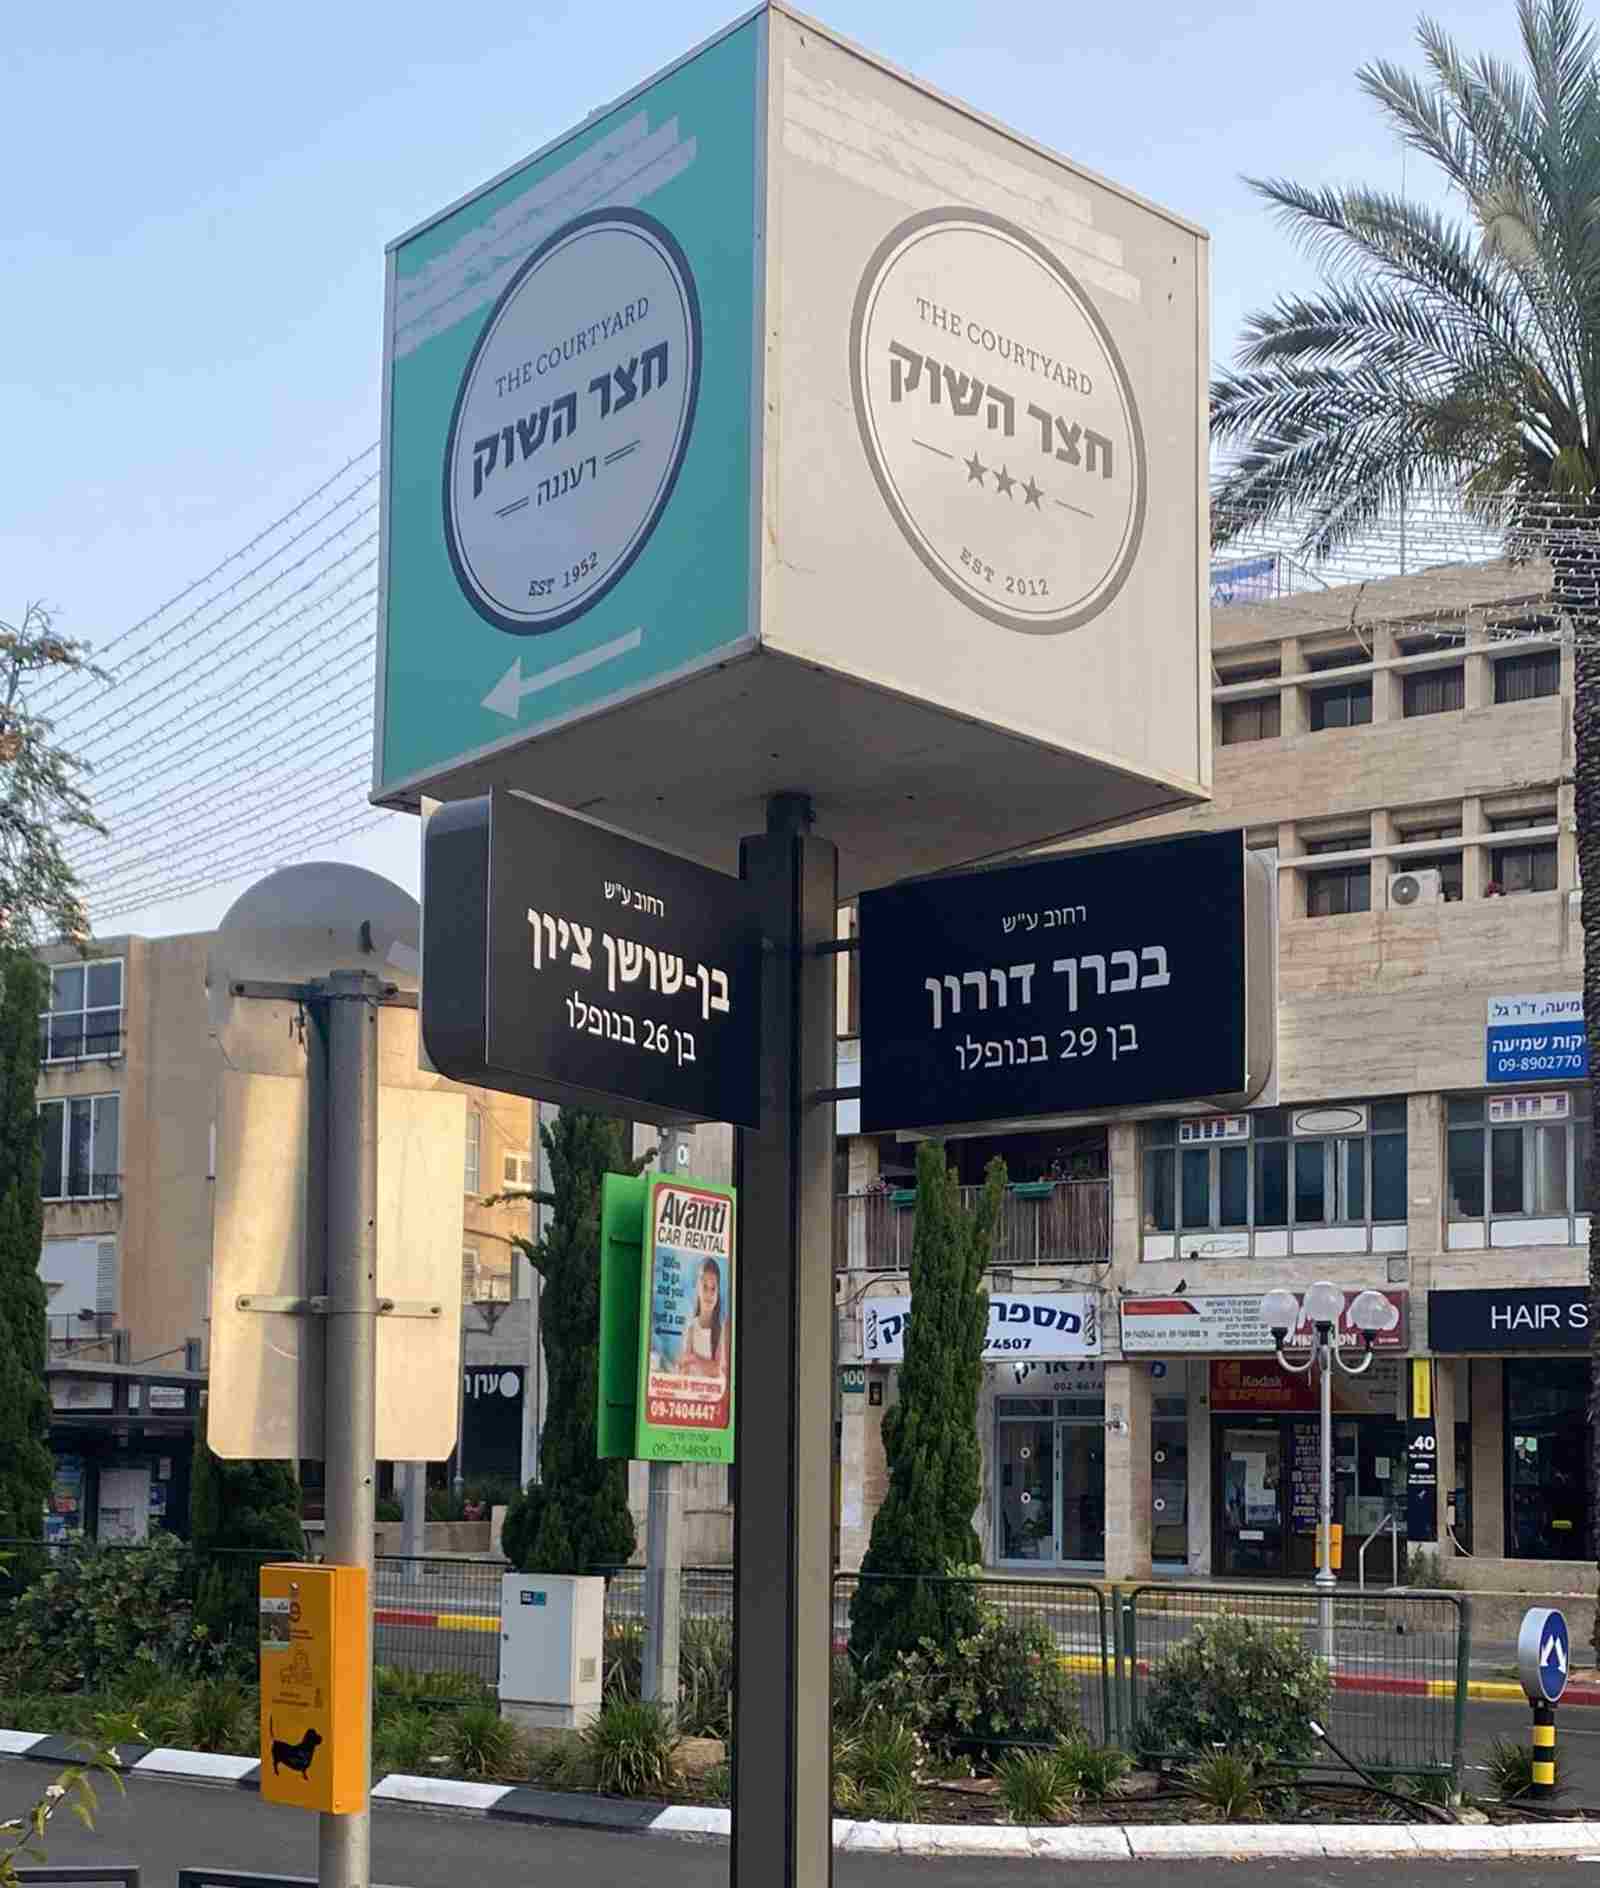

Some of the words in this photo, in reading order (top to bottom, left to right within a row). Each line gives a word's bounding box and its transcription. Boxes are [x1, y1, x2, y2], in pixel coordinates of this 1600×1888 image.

[495, 363, 533, 398] THE
[536, 296, 649, 377] COURTYARD
[915, 297, 962, 337] THE
[967, 322, 1093, 396] COURTYARD
[587, 340, 669, 421] חצר
[888, 339, 1016, 437] השוק
[473, 392, 577, 500] השוק
[1027, 402, 1113, 480] חצר
[536, 454, 598, 507] רעננה
[528, 577, 555, 598] EST
[563, 551, 598, 588] 1952
[959, 546, 995, 583] EST
[1005, 576, 1049, 597] 2012
[633, 889, 664, 918] רחוב
[1044, 905, 1087, 928] רחוב
[527, 908, 593, 970] ציון
[925, 962, 1036, 1030] דורון
[1052, 945, 1171, 1012] בכרך
[565, 990, 636, 1046] בנופלו
[1541, 1000, 1585, 1016] מיעה,
[643, 1019, 670, 1054] 26
[674, 1027, 696, 1067] בן
[955, 1034, 1049, 1071] בנופלו
[1060, 1026, 1097, 1060] 29
[1106, 1023, 1139, 1062] בן
[1492, 1036, 1548, 1053] שמיעה
[1498, 1054, 1582, 1072] 09-8902770
[660, 1191, 727, 1234] Avanti
[658, 1226, 681, 1245] CAR
[684, 1230, 725, 1253] RENTAL
[988, 1301, 1081, 1334] מספר
[1491, 1304, 1561, 1330] HAIR
[1568, 1303, 1592, 1328] S
[983, 1338, 1032, 1350] 74507
[843, 1369, 865, 1386] 100
